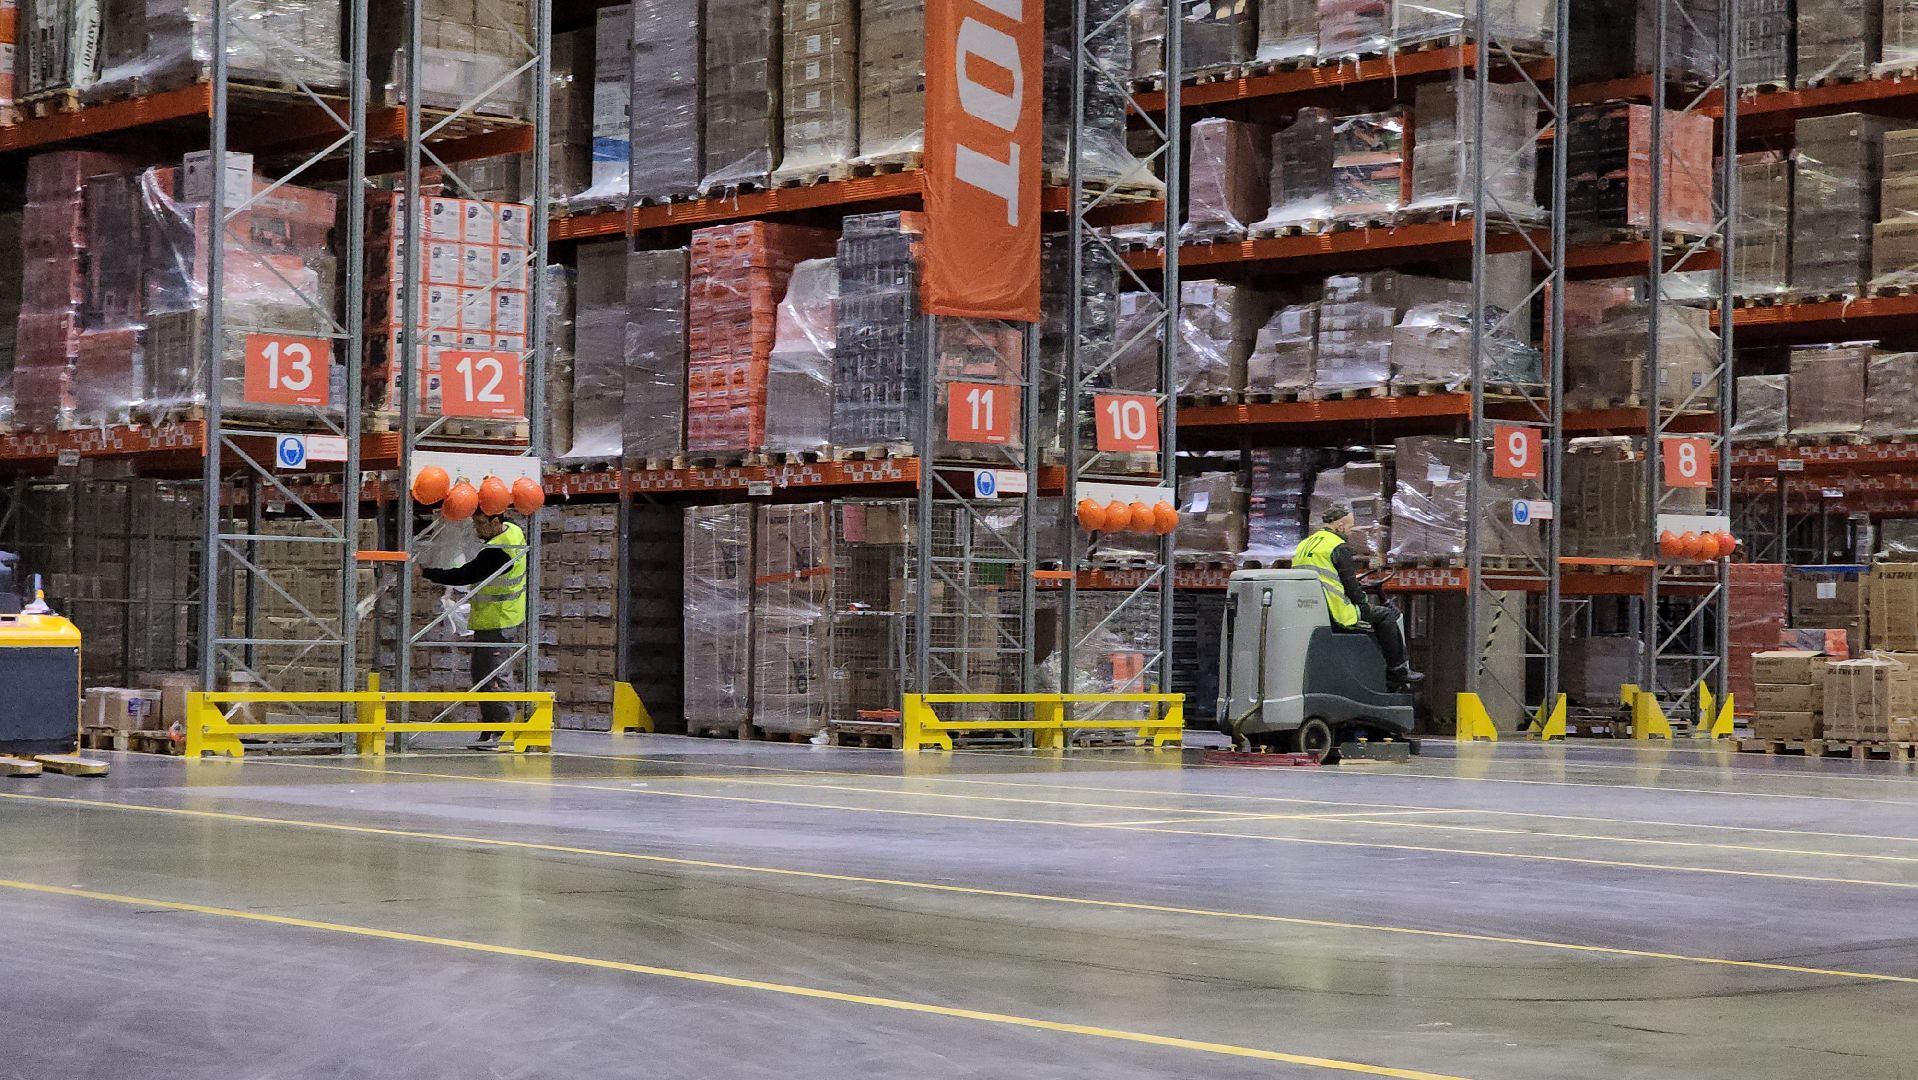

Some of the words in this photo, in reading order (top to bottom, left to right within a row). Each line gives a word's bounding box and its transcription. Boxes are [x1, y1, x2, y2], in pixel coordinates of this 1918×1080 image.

[261, 341, 313, 391] 13
[455, 356, 505, 403] 12
[966, 388, 994, 431] 11
[1106, 399, 1147, 440] 10
[1508, 431, 1528, 468] 9
[1678, 442, 1698, 478] 8
